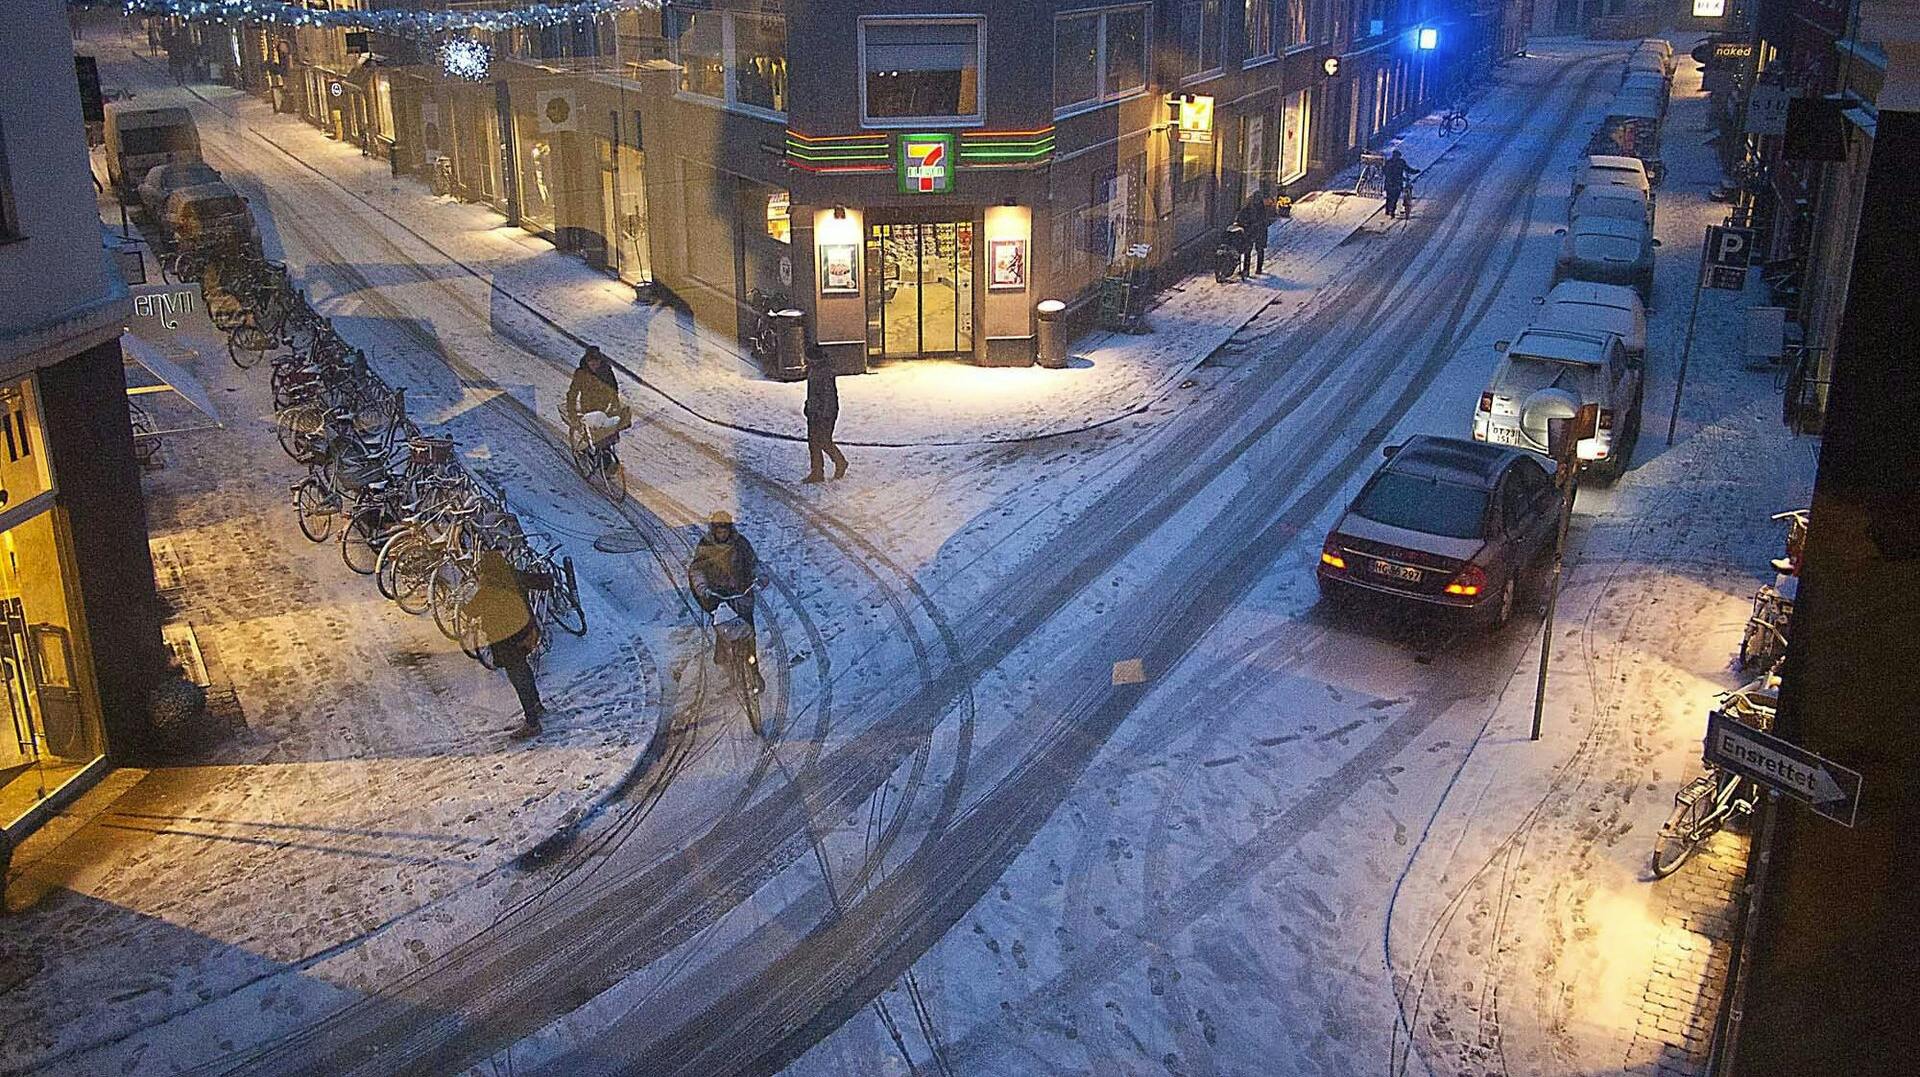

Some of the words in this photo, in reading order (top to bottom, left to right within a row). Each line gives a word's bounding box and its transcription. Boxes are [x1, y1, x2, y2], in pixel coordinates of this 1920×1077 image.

[1716, 47, 1752, 56] naked
[908, 143, 944, 192] 7
[1718, 233, 1743, 261] P
[1375, 562, 1388, 573] HG
[1402, 568, 1420, 580] 297
[1722, 734, 1817, 791] Ensrettet
